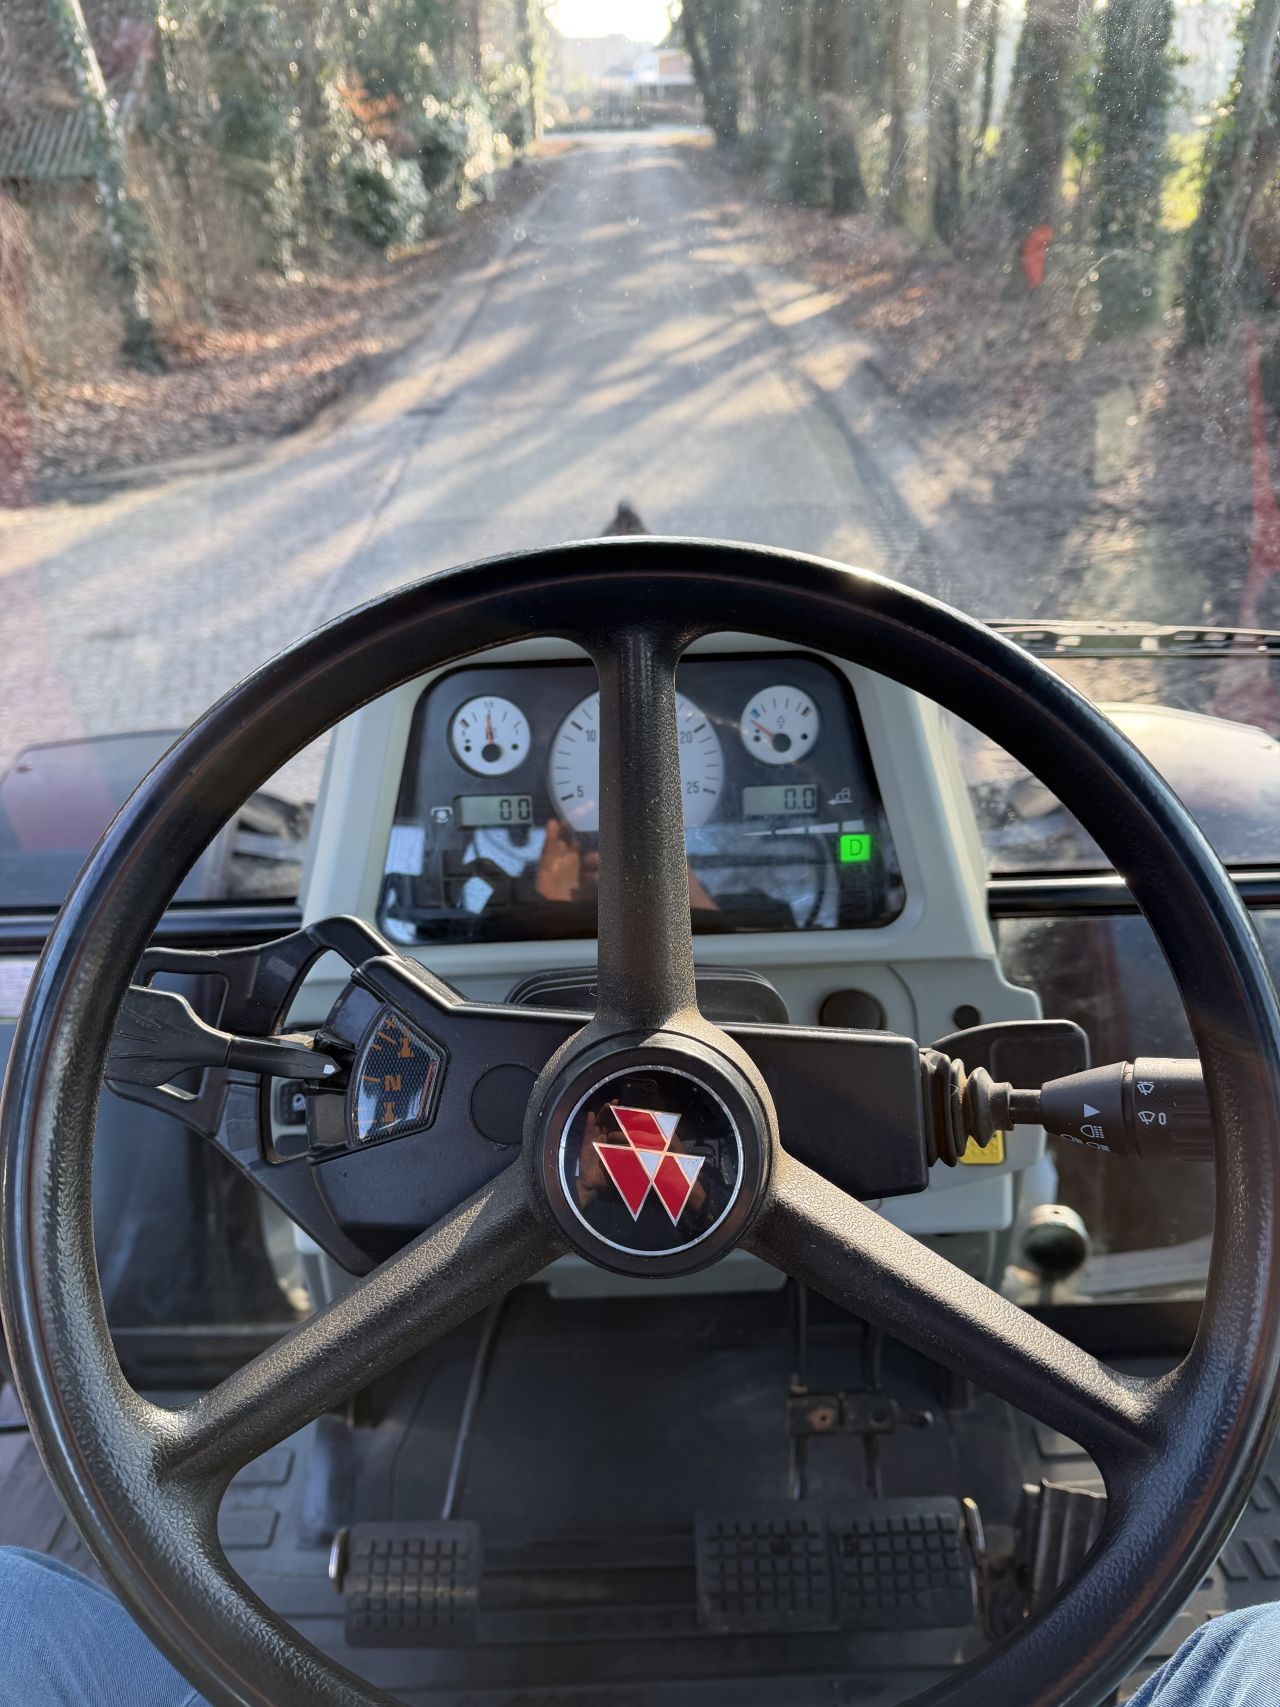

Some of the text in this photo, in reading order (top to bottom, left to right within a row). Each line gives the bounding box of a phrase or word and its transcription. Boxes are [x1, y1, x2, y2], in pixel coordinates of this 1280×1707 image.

[586, 729, 597, 742] 10
[679, 731, 693, 744] 20
[577, 786, 584, 798] 5
[686, 782, 700, 794] 25
[784, 788, 815, 810] 0.0
[849, 839, 863, 856] D
[384, 1075, 401, 1091] N
